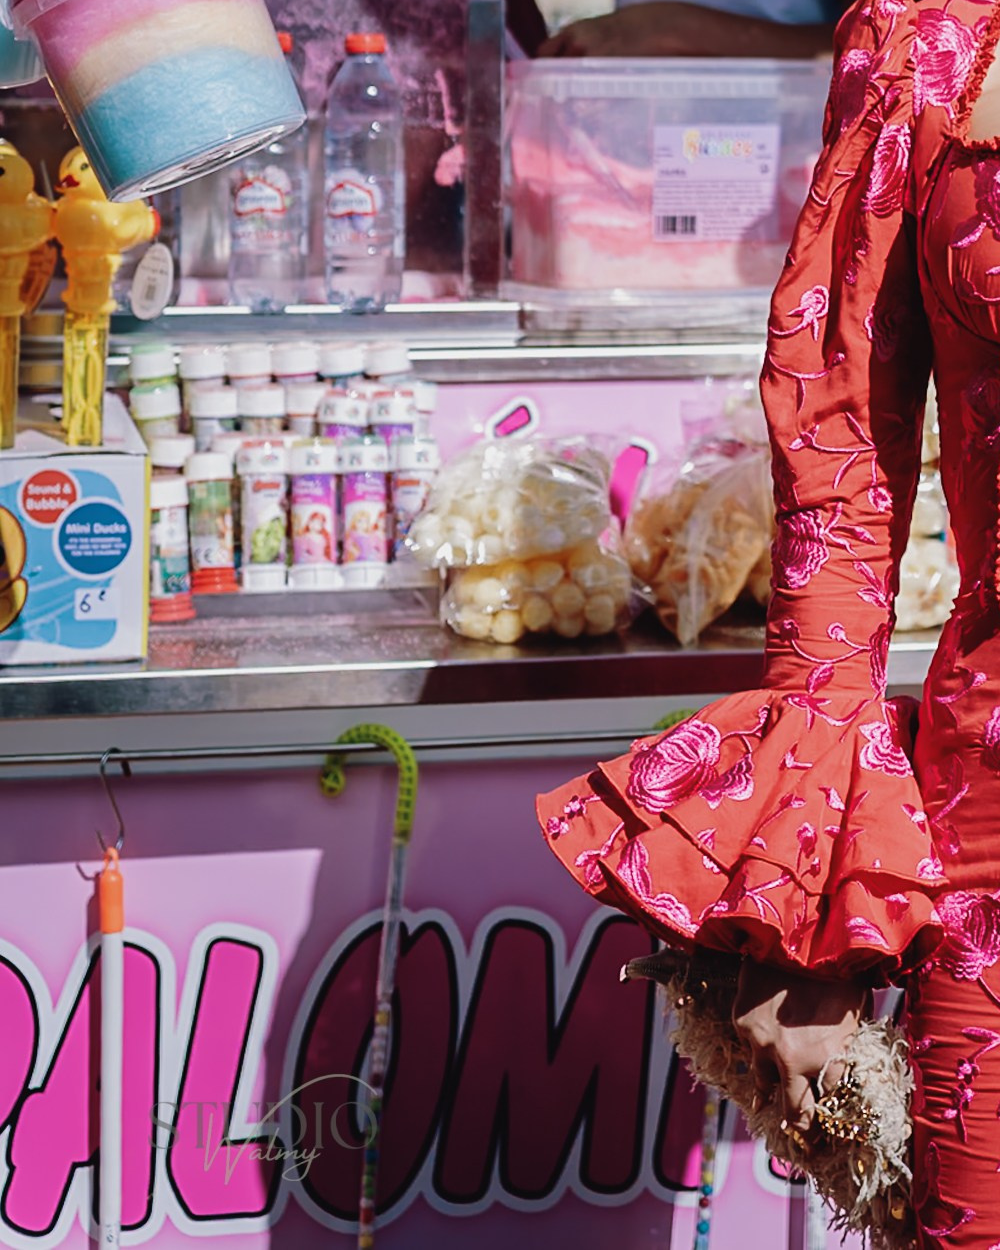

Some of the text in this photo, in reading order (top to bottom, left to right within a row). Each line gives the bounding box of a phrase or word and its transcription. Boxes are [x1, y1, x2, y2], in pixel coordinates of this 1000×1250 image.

[28, 483, 71, 494] Sound &
[26, 497, 69, 510] Bubble
[66, 522, 127, 534] Mini Ducks
